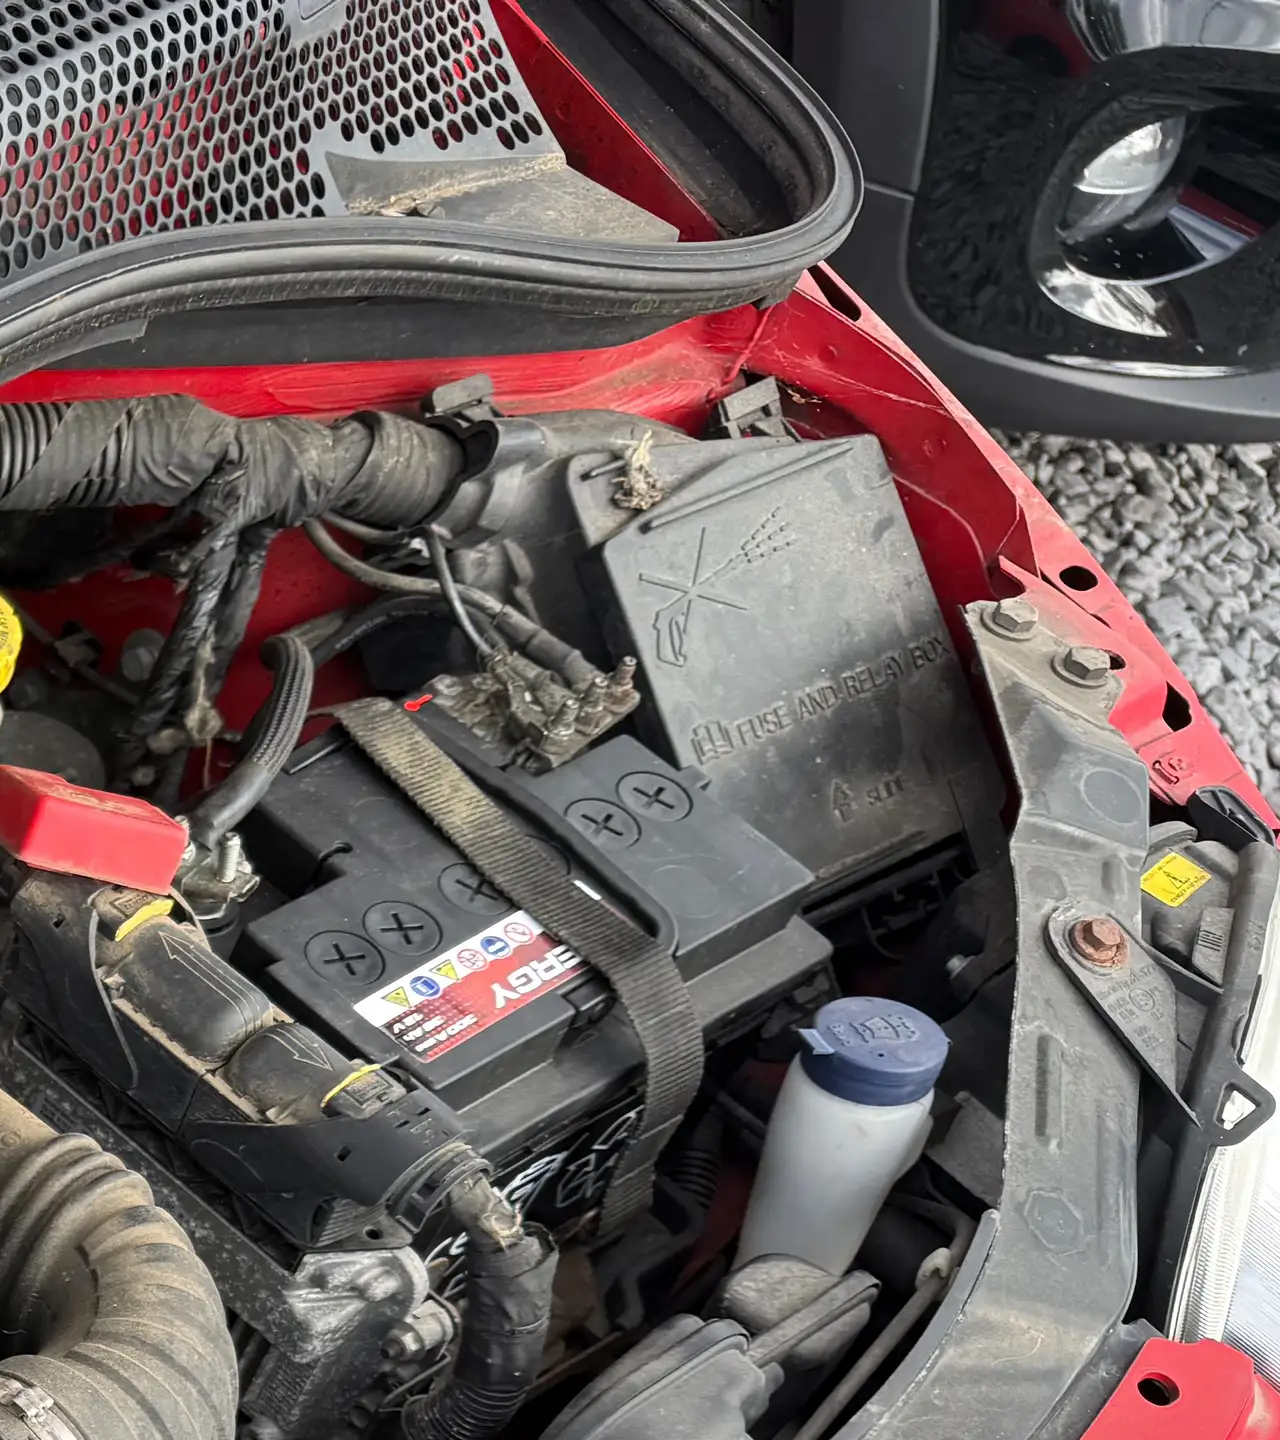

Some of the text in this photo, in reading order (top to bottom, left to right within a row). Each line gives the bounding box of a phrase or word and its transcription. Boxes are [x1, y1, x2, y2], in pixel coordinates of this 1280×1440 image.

[733, 634, 954, 747] FUSE AND RELAY BOX
